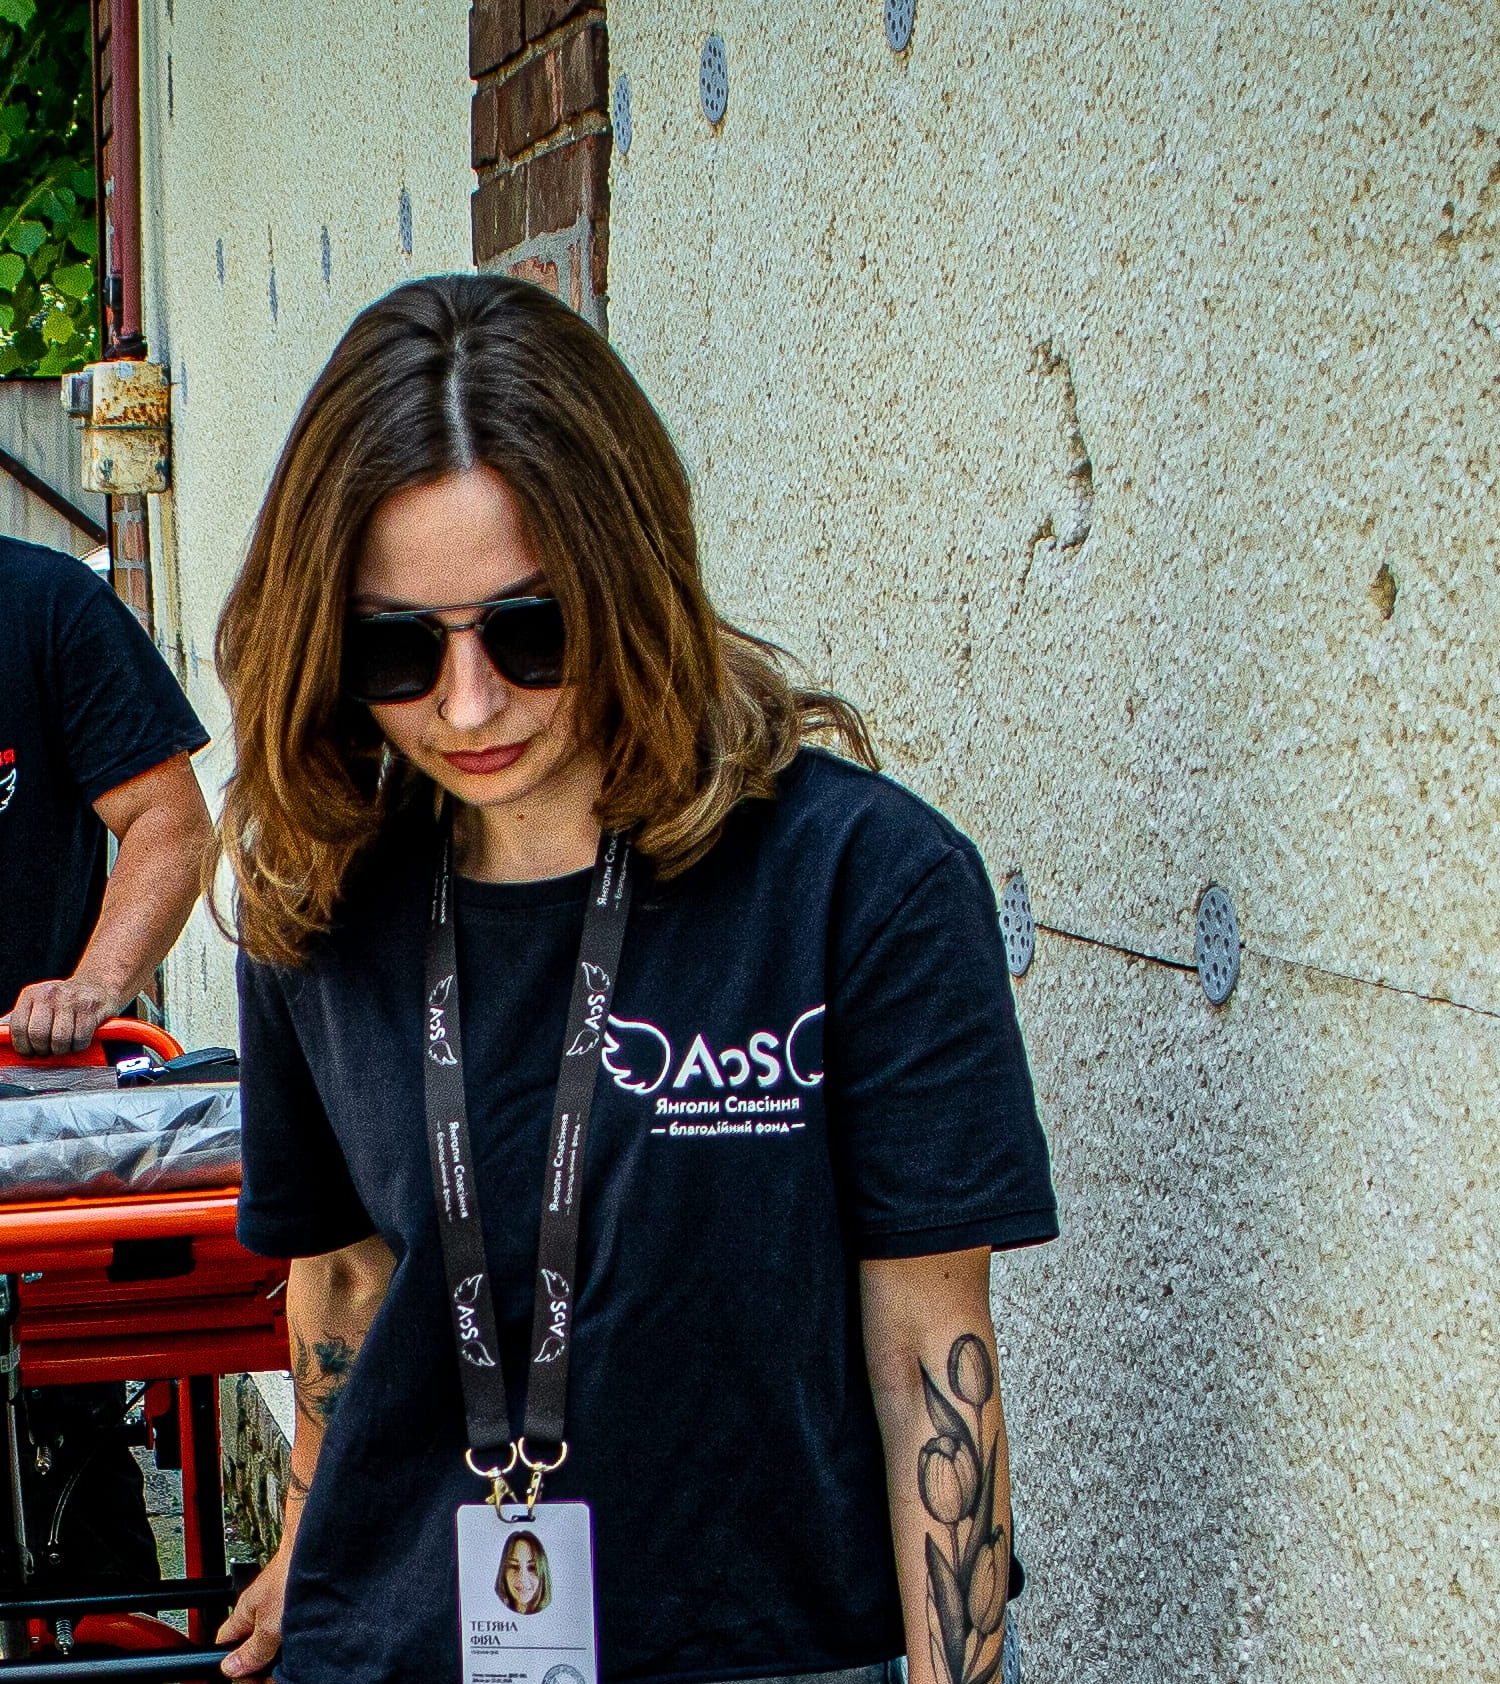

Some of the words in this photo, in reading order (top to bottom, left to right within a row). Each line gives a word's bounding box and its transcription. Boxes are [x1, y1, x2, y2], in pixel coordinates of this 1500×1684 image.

[655, 1097, 720, 1115] Янголи
[725, 1095, 801, 1114] Спасіння
[669, 1121, 753, 1137] благодійний
[755, 1122, 790, 1135] фонд
[470, 1620, 518, 1632] ТЕТЯНА
